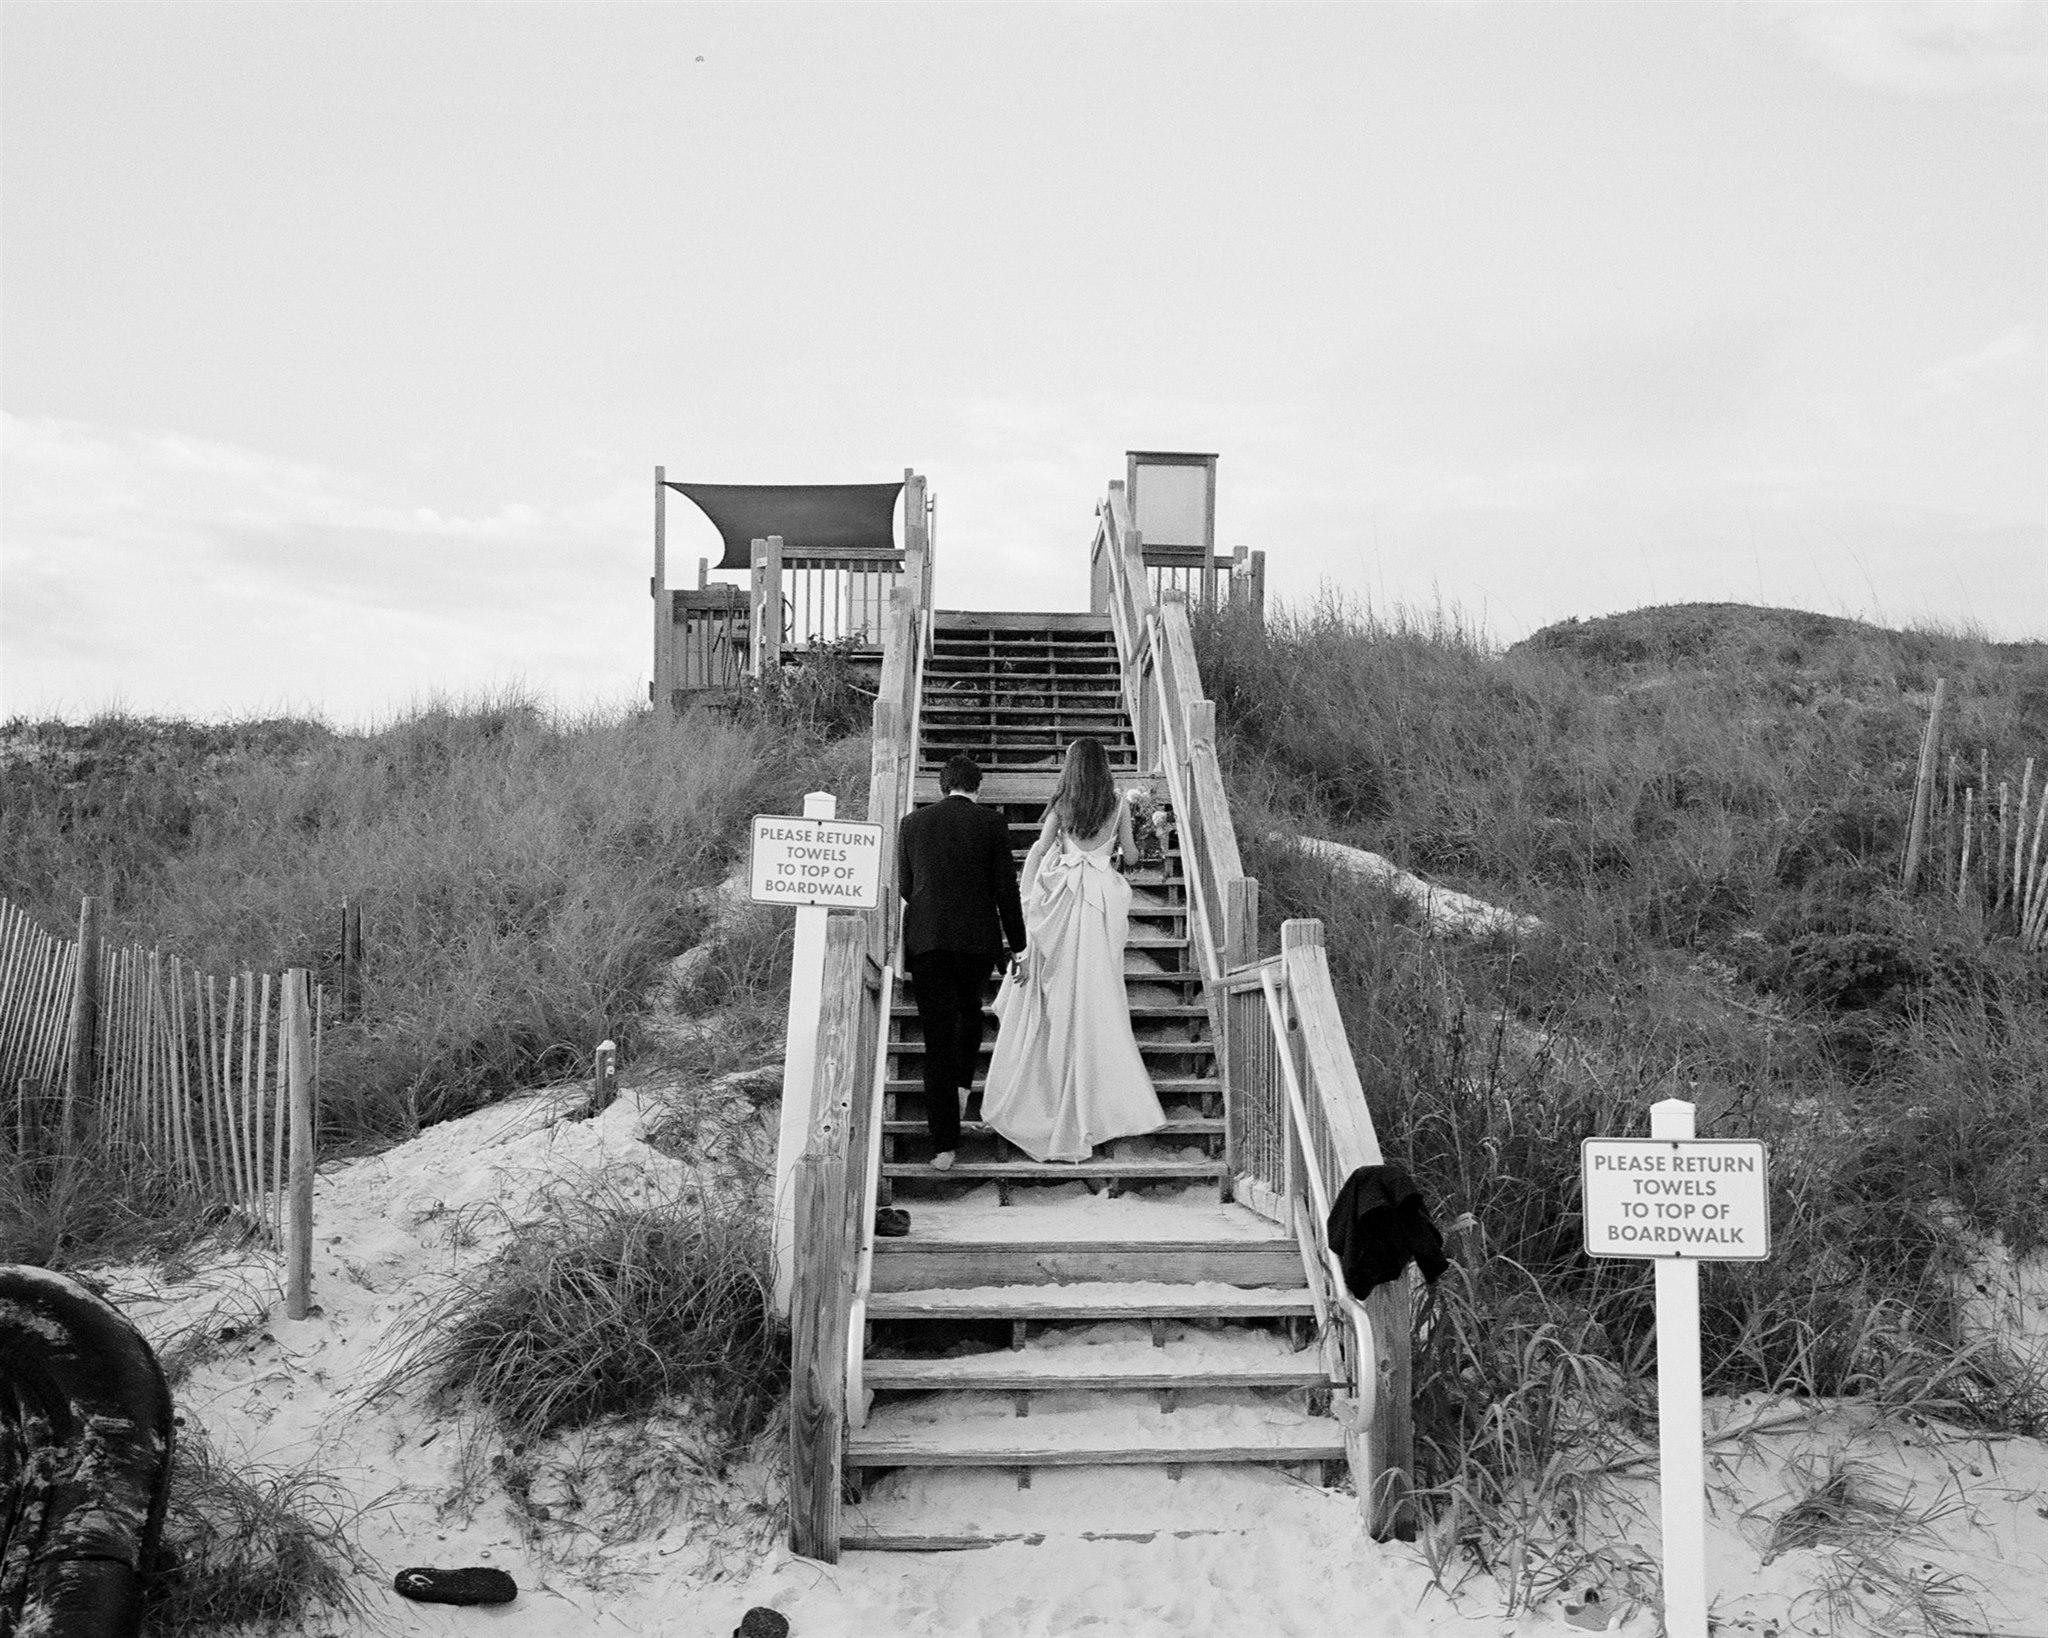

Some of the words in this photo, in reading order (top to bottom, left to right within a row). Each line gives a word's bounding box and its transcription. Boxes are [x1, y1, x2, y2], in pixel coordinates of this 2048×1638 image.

[760, 827, 812, 842] PLEASE
[816, 831, 876, 846] RETURN
[786, 846, 847, 862] TOWELS
[777, 863, 796, 876] TO
[800, 864, 830, 878] TOP
[833, 867, 855, 879] OF
[765, 879, 863, 898] BOARDWALK
[1594, 1155, 1666, 1172] PLEASE
[1672, 1156, 1754, 1173] RETURN
[1632, 1179, 1717, 1197] TOWELS
[1621, 1202, 1649, 1218] TO
[1654, 1203, 1696, 1220] TOP
[1701, 1203, 1730, 1220] OF
[1608, 1225, 1745, 1244] BOARDWALK
